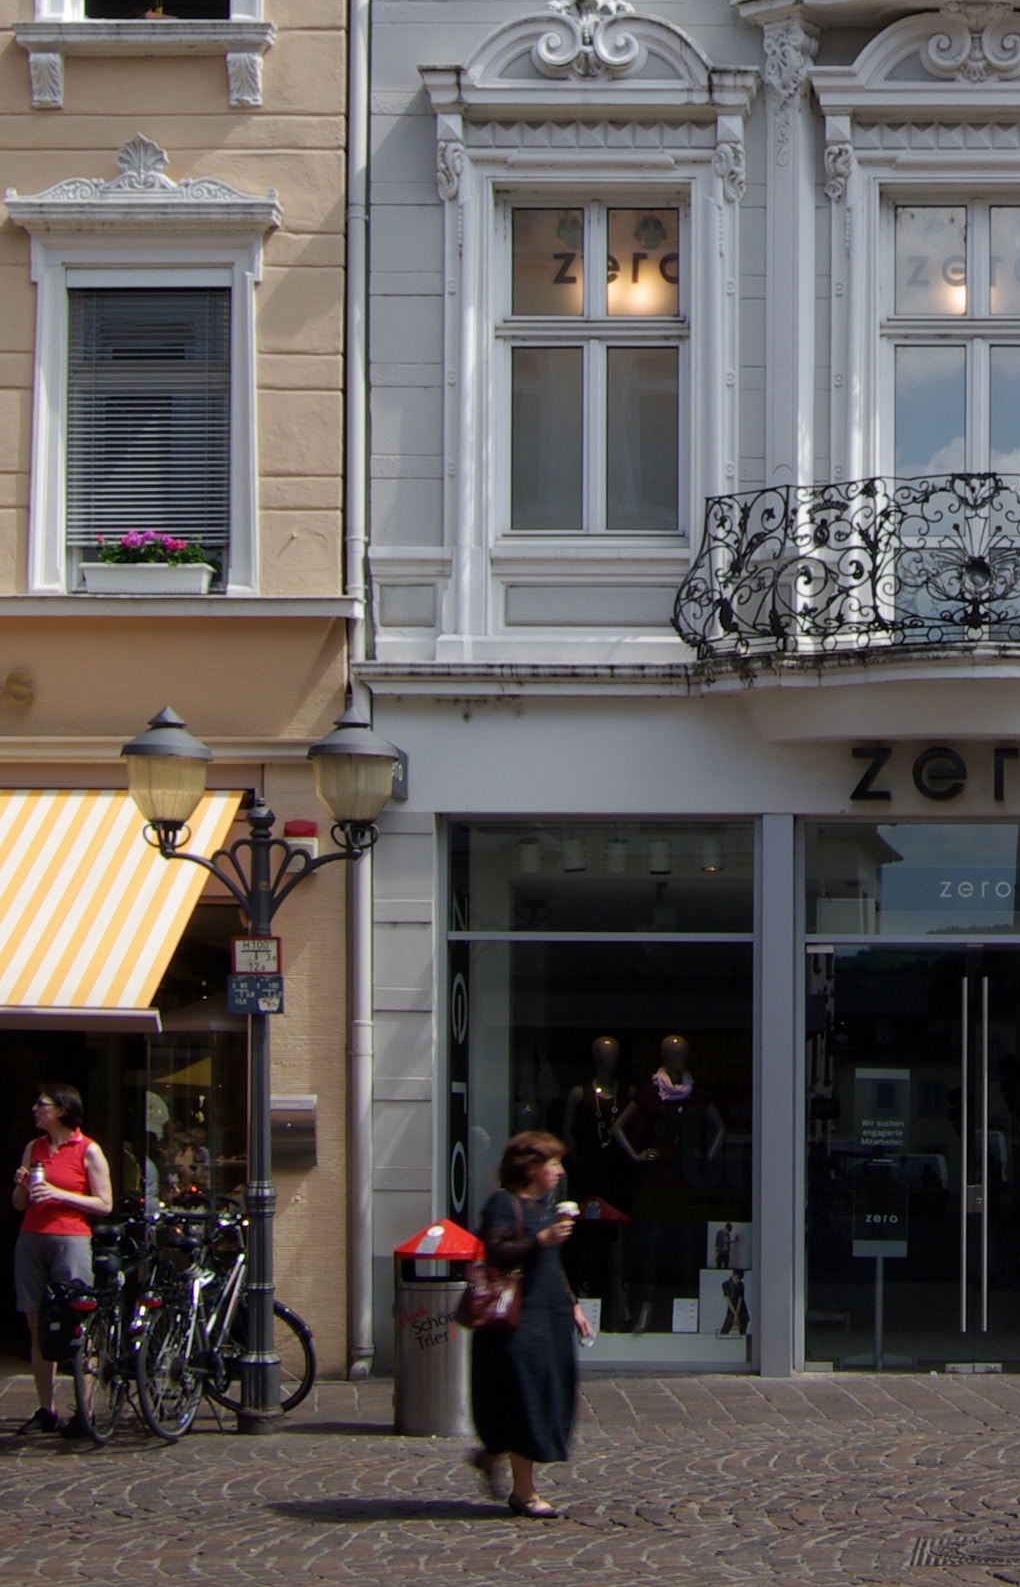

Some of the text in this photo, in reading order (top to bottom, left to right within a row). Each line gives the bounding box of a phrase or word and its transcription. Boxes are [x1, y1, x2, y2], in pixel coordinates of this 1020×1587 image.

[939, 880, 1013, 898] zero
[861, 1119, 905, 1127] Wir suchen
[865, 1214, 899, 1224] zero
